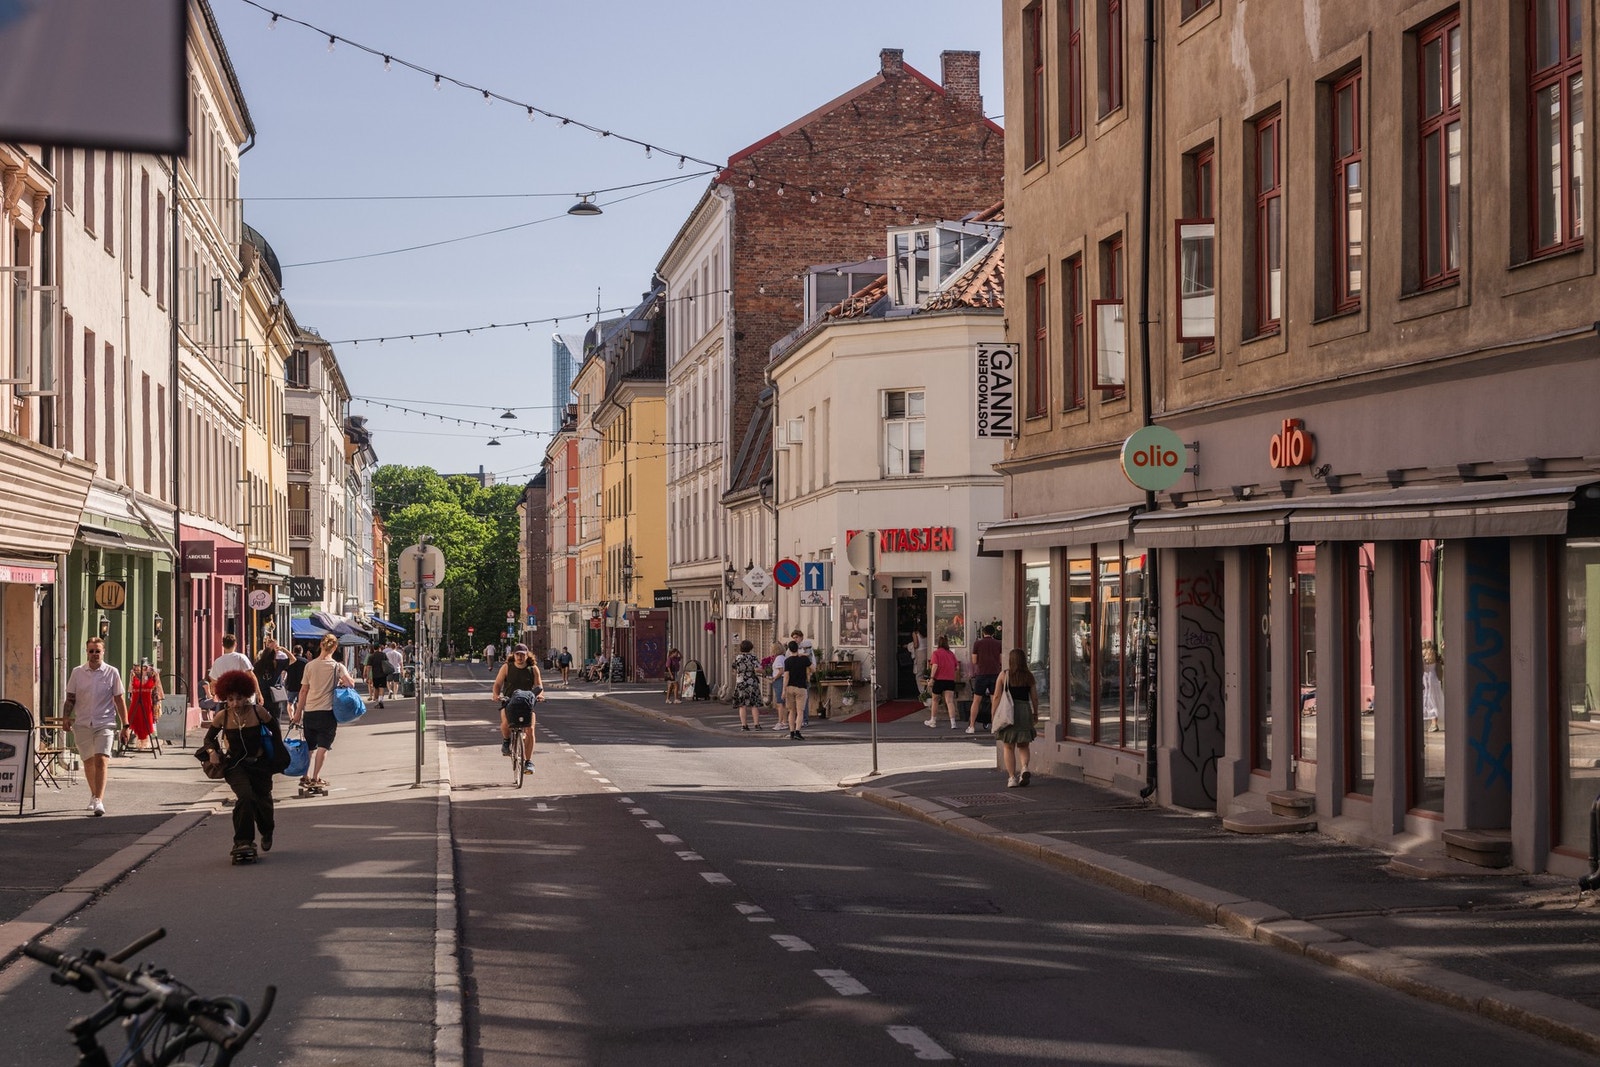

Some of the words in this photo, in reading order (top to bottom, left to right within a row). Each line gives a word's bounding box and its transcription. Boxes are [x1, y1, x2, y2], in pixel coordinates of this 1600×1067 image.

[979, 350, 988, 436] POSTMODERN
[990, 350, 1012, 437] GANNI
[1133, 445, 1178, 467] olio
[1270, 419, 1304, 469] olio
[846, 527, 956, 553] PNTASJEN
[294, 582, 311, 590] NOA
[0, 772, 15, 780] ar
[0, 783, 14, 793] nt
